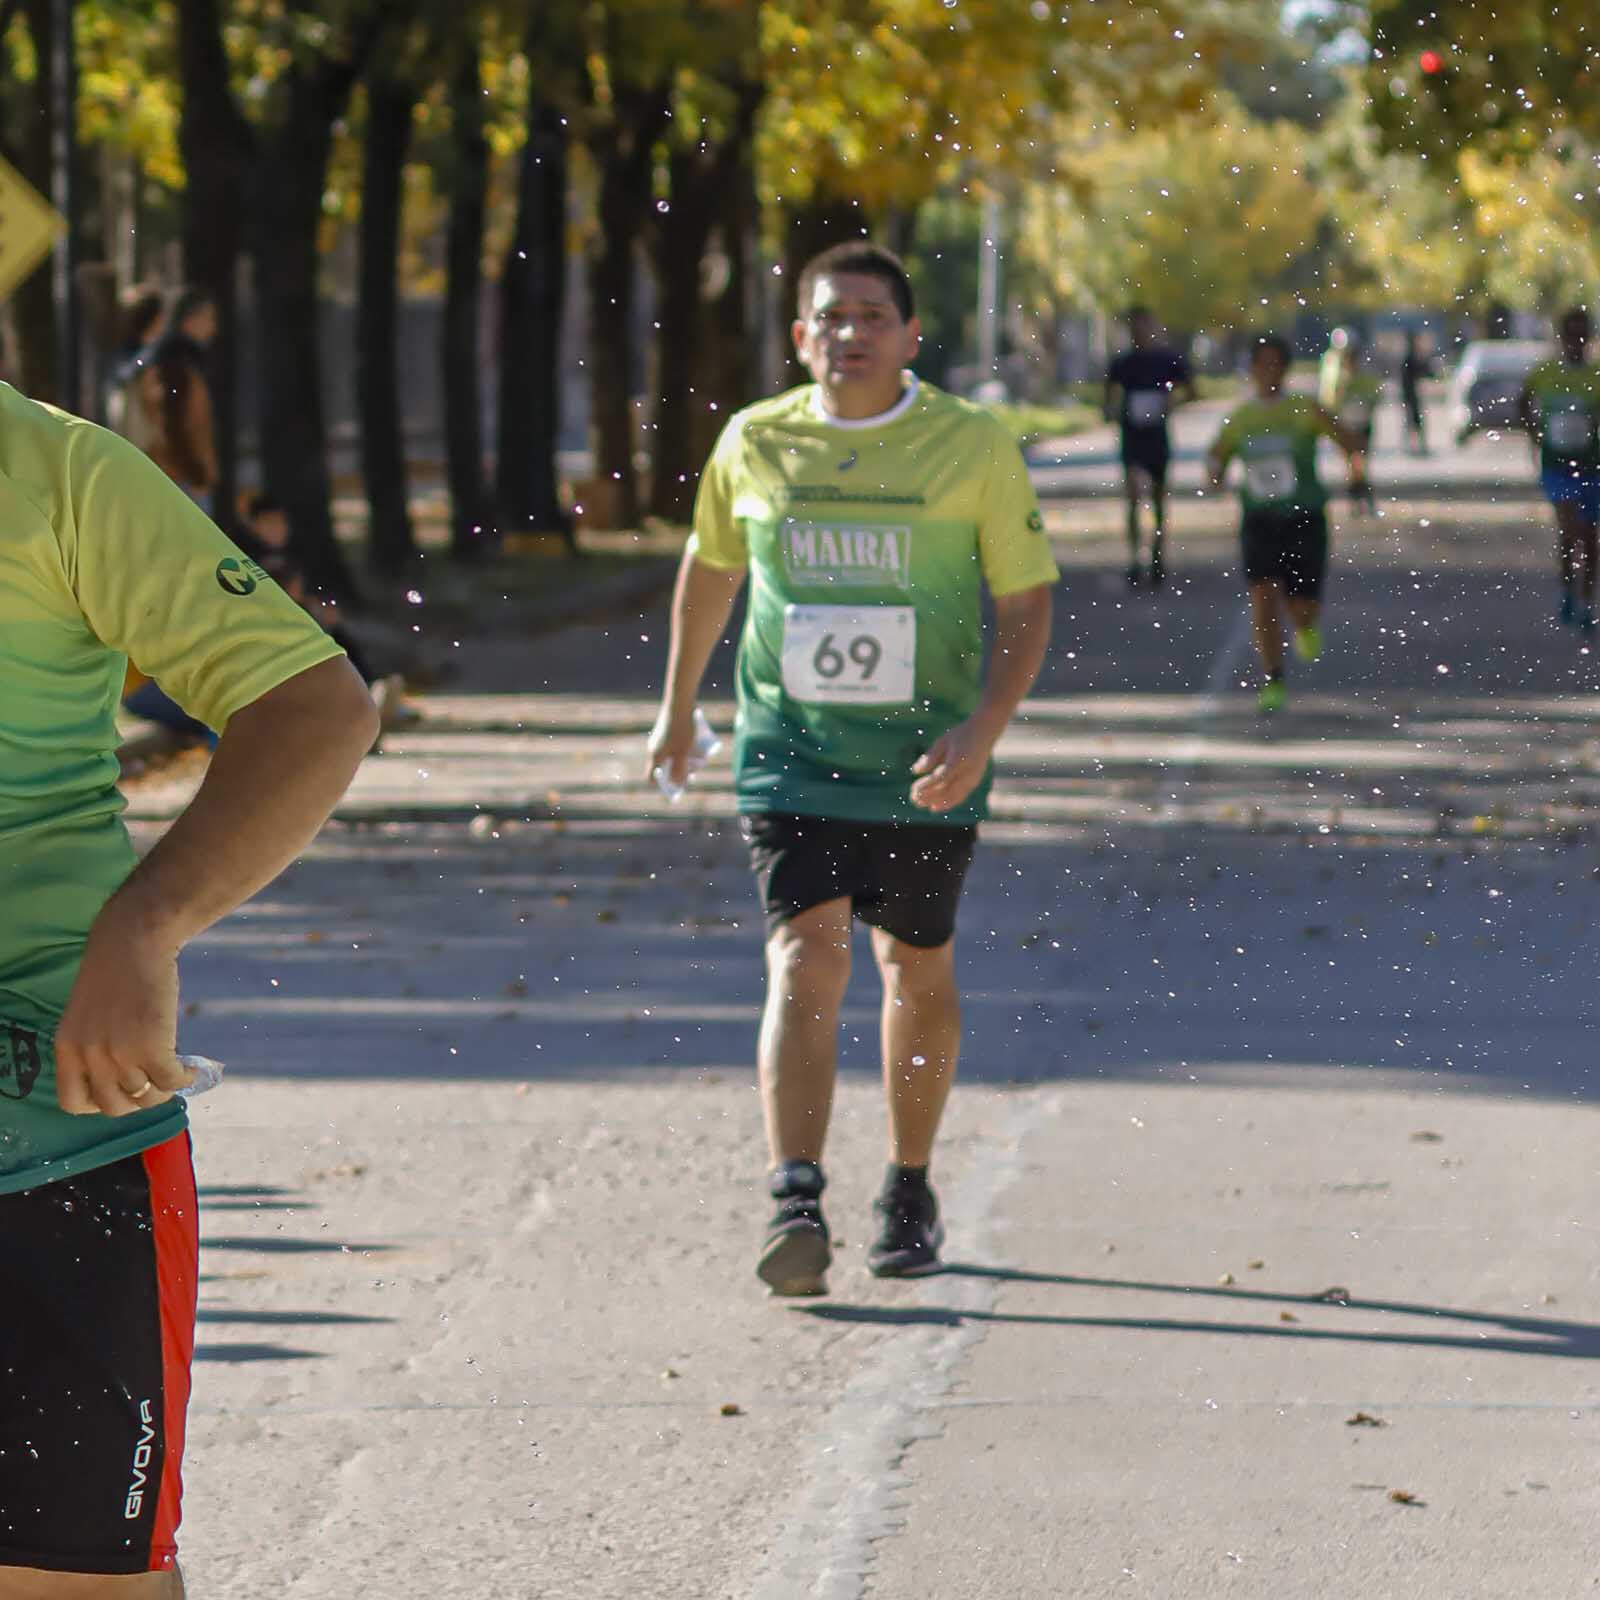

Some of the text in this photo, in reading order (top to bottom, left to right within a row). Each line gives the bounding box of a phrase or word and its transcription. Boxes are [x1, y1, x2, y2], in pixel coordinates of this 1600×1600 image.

[791, 529, 900, 568] MAIRA
[813, 633, 882, 679] 69
[125, 1399, 155, 1519] GIVOVA
